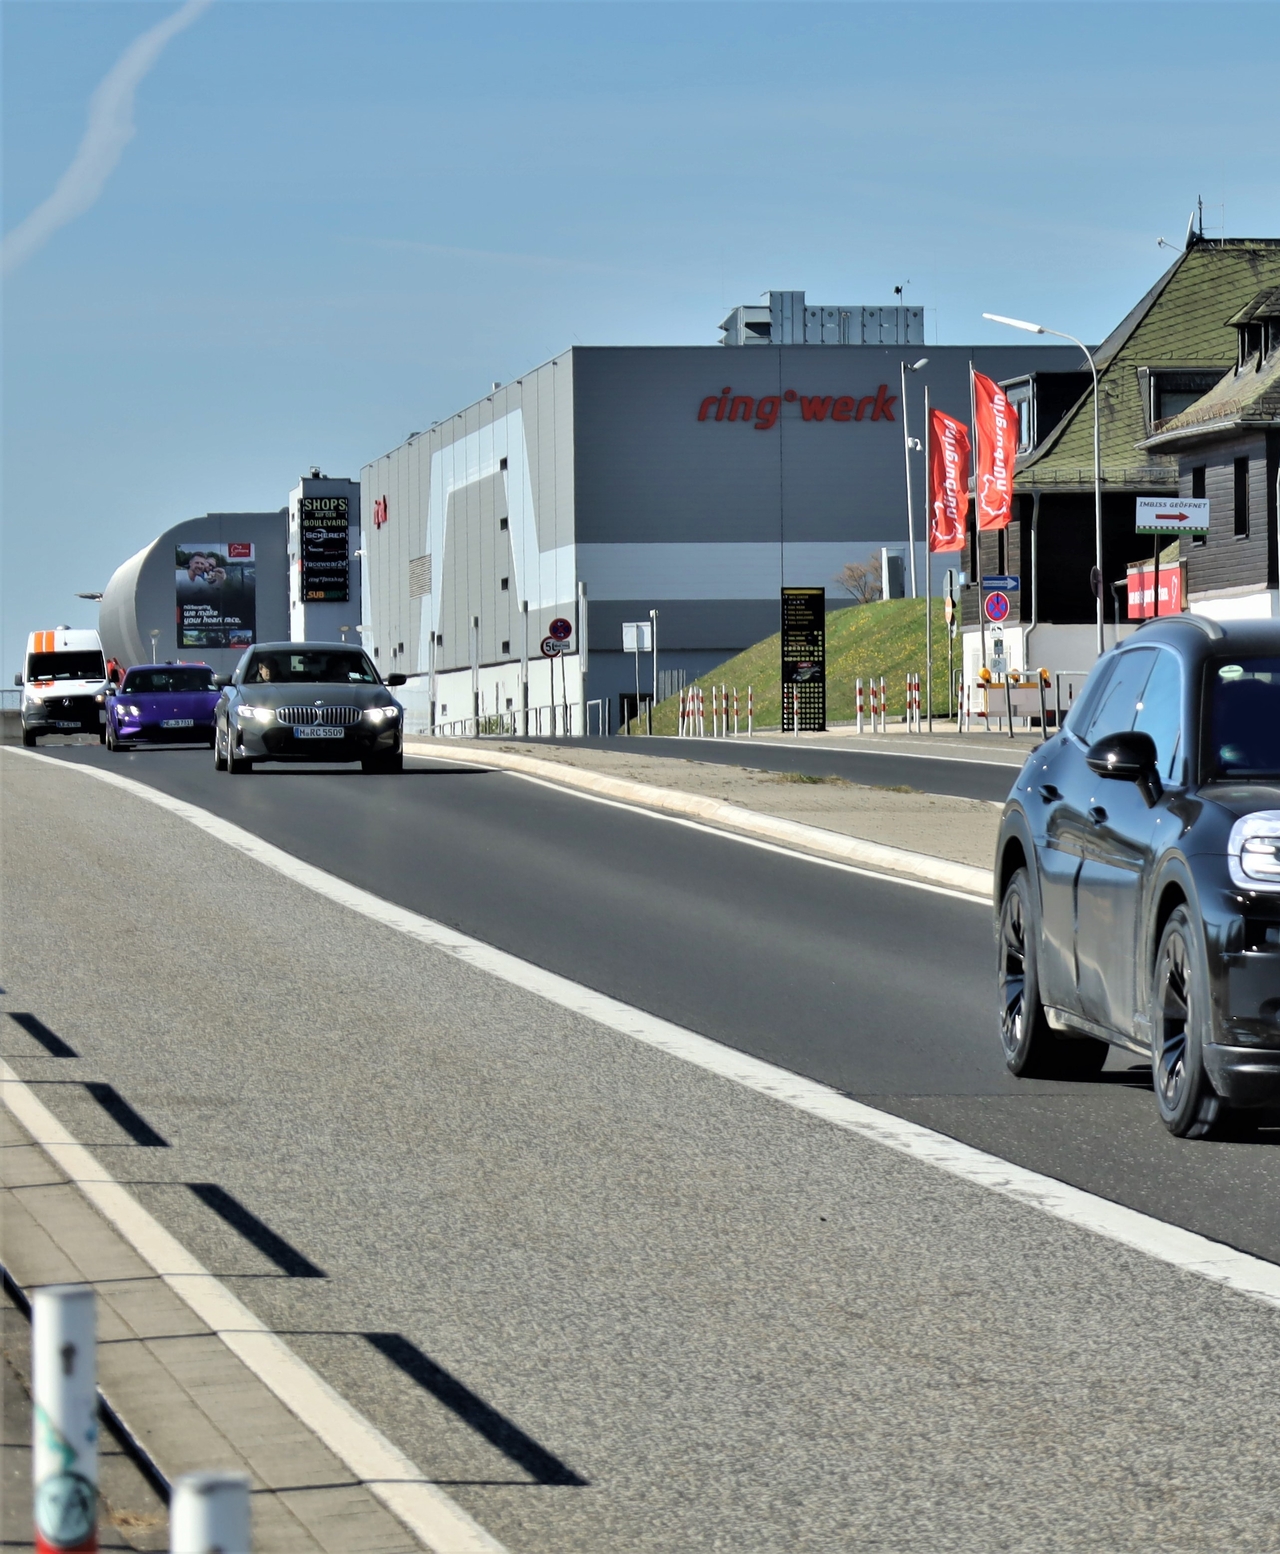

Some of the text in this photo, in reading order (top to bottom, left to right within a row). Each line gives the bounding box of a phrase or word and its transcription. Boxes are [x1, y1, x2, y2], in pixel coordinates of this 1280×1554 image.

[942, 419, 958, 520] nürburgring
[304, 499, 346, 510] SHOPS
[1169, 501, 1207, 509] GEÖFFNET
[304, 519, 346, 527] BOULEVARD
[305, 560, 346, 568] racewear24
[197, 609, 218, 617] make
[183, 616, 241, 625] your heart race.
[310, 728, 321, 737] RC
[322, 728, 343, 737] 5509
